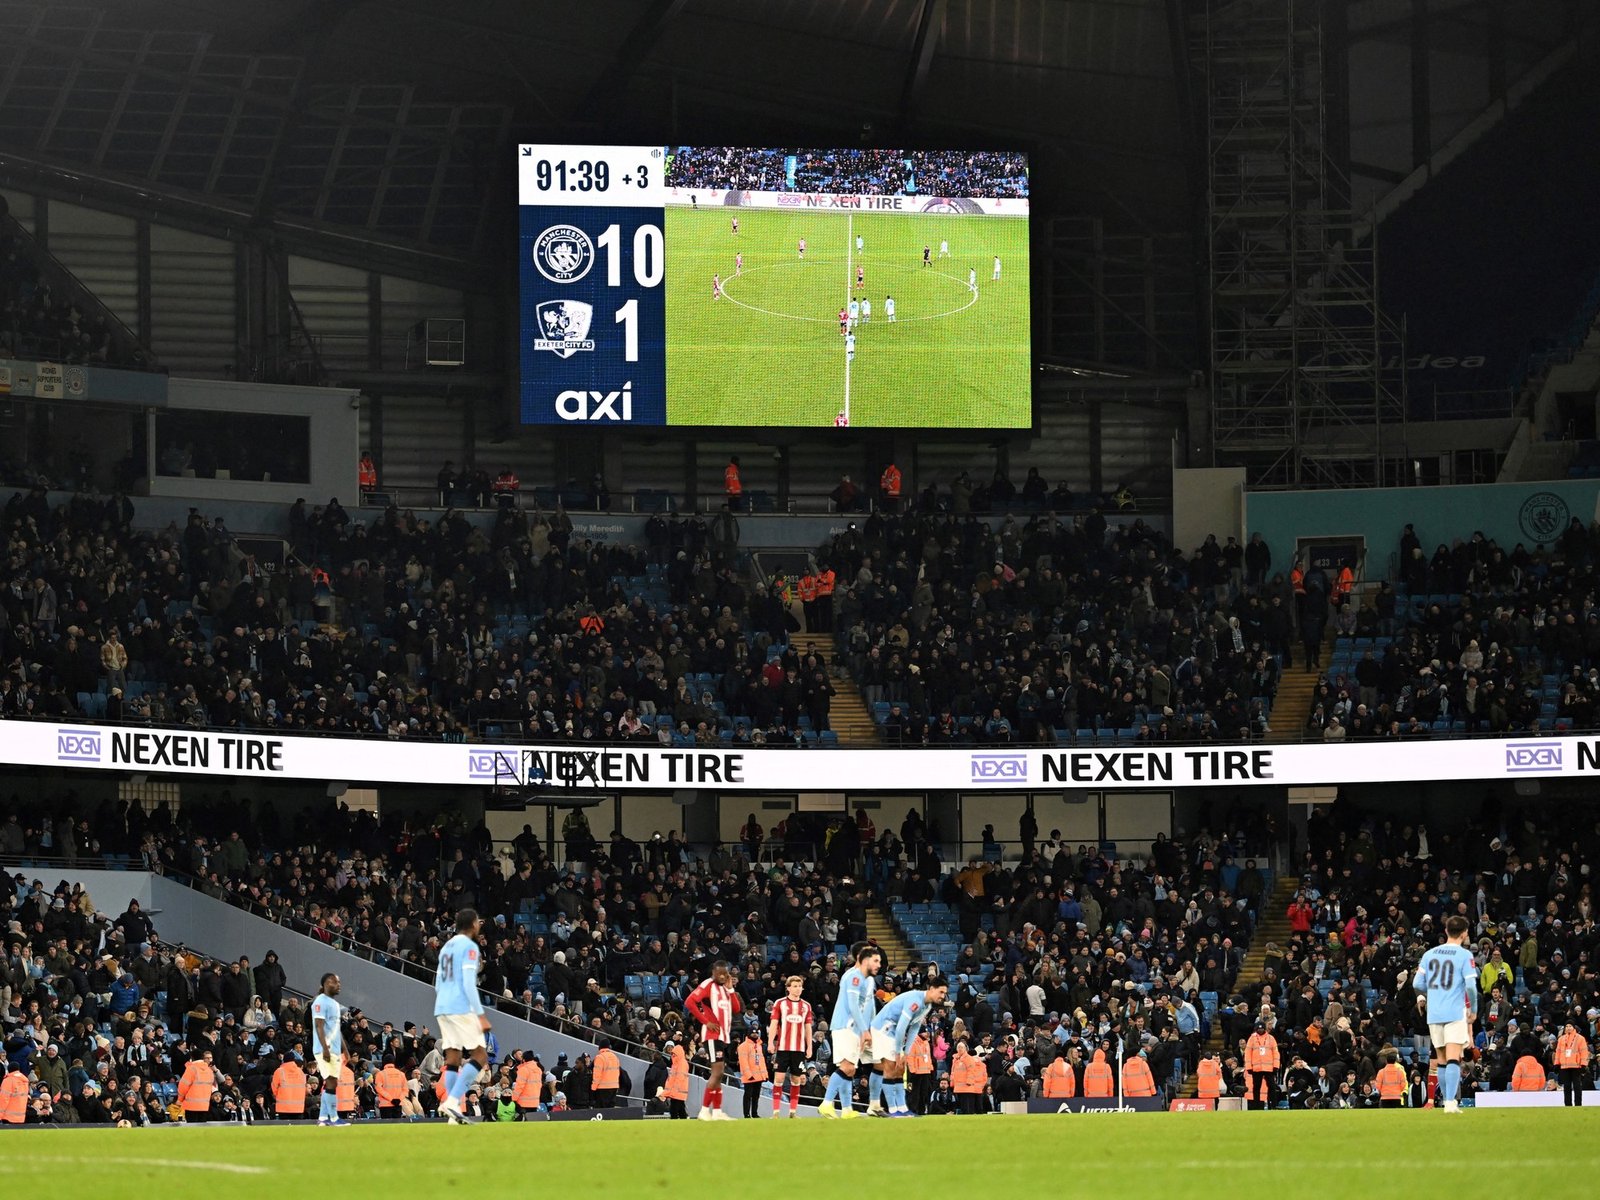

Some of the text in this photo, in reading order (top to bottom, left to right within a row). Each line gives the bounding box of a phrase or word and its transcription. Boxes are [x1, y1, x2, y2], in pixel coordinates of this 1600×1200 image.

[536, 159, 610, 192] 91:39
[807, 195, 903, 210] NEXEN TIRE
[540, 229, 588, 248] MANCHESTER
[597, 223, 665, 288] 10
[582, 341, 592, 349] FC
[615, 299, 639, 362] 1
[555, 380, 632, 421] axi
[58, 735, 101, 756] NEXEN
[111, 731, 284, 772] NEXEN TIRE
[1506, 747, 1563, 766] NEXEN
[469, 755, 518, 774] NEXEN
[529, 751, 744, 783] NEXEN TIRE
[971, 759, 1028, 777] NEXEN
[1041, 750, 1274, 782] NEXEN TIRE
[1428, 958, 1454, 991] 20
